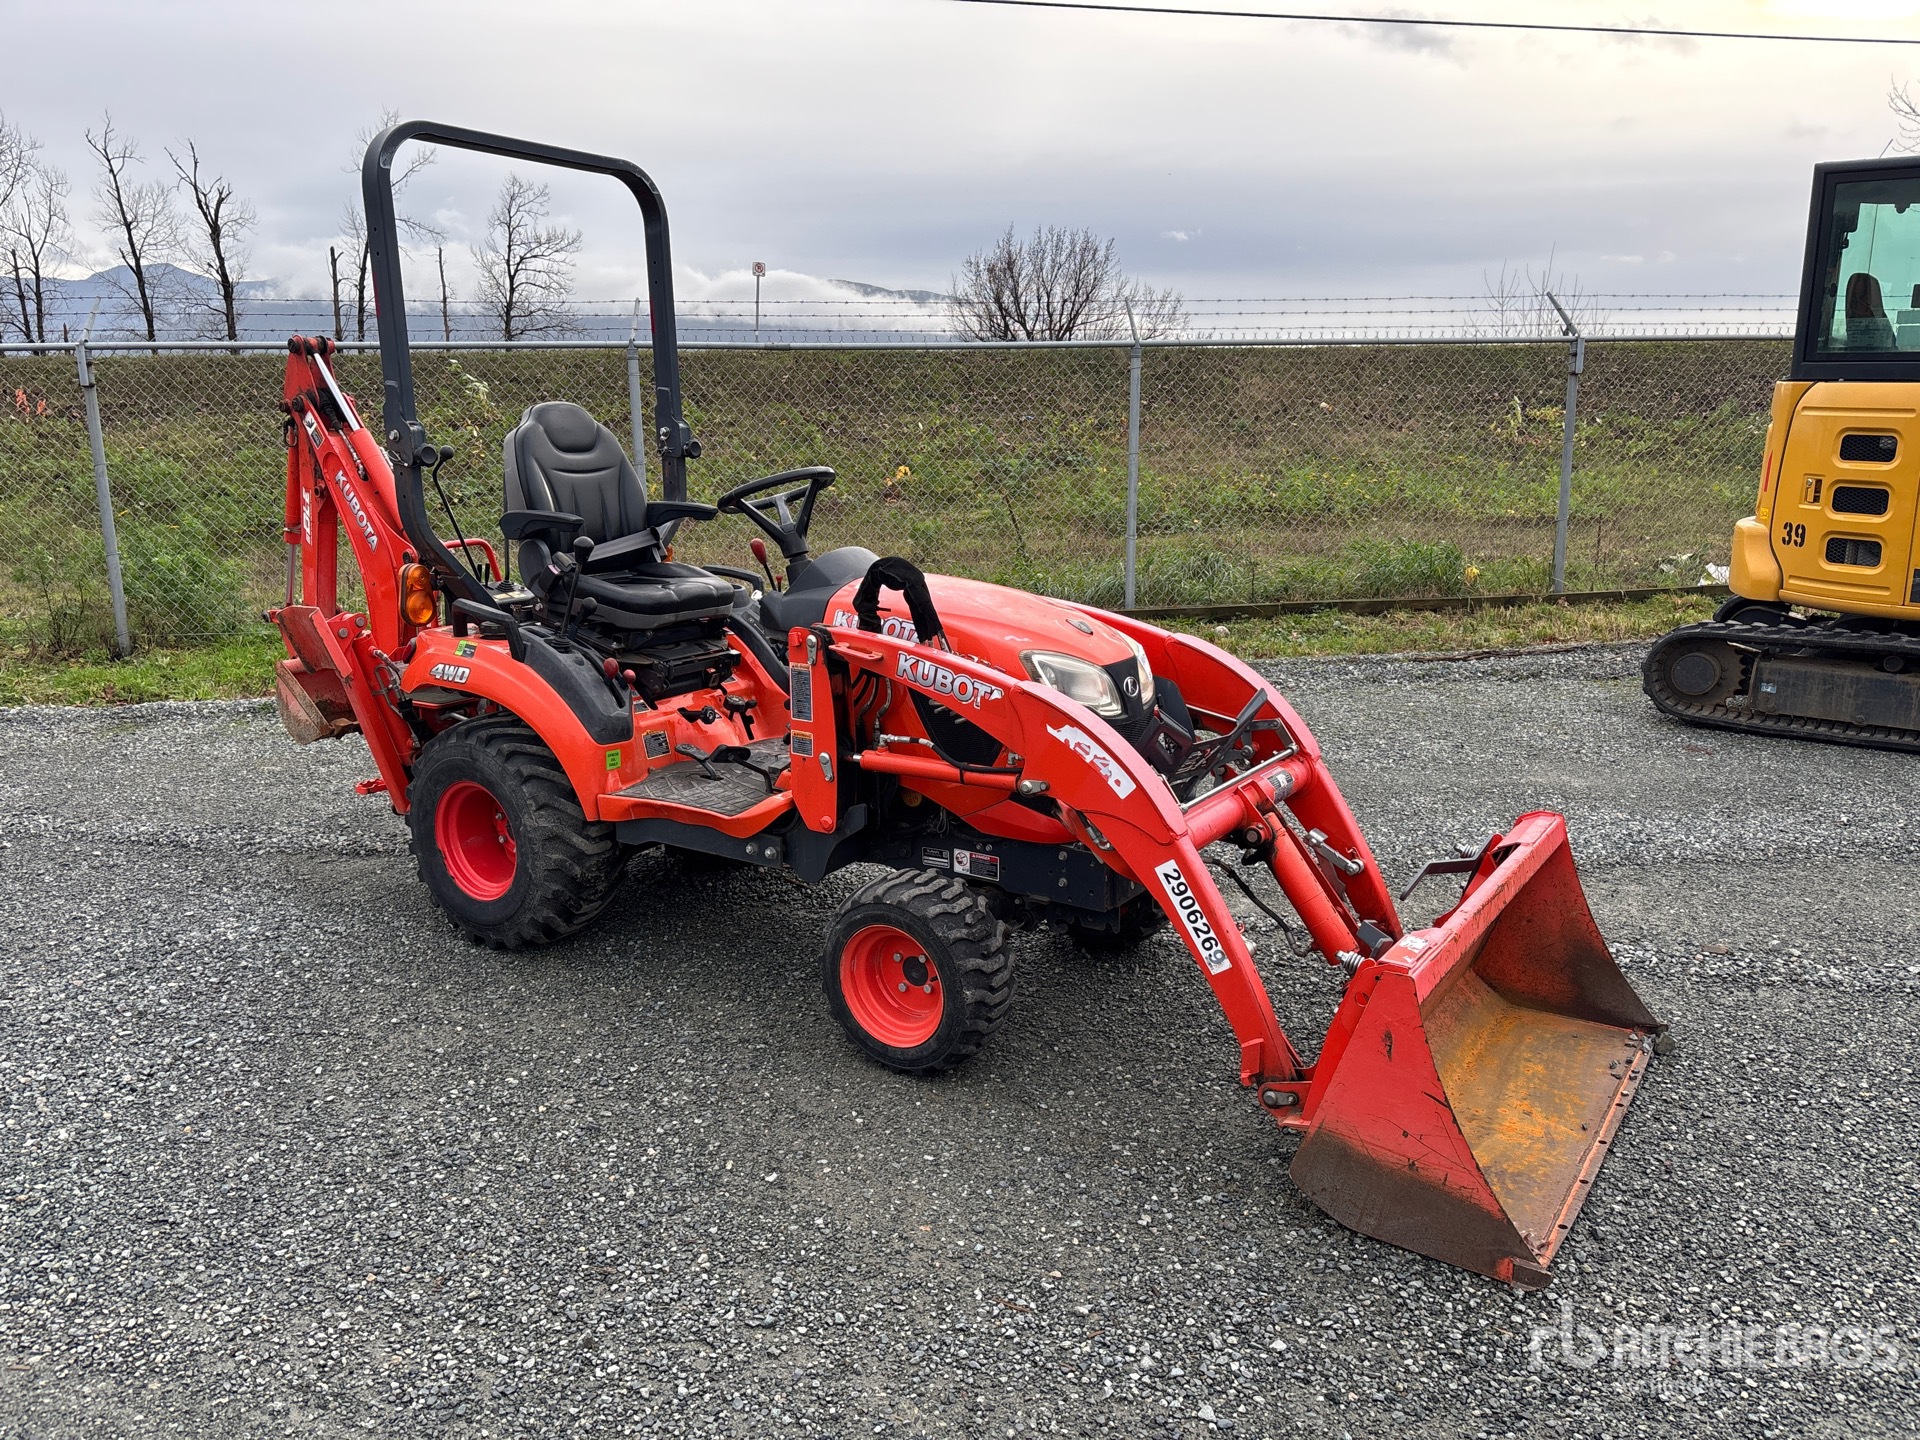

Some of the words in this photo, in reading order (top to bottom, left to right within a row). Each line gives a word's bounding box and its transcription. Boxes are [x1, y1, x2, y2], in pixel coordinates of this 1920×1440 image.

[335, 470, 378, 553] KUBOTA
[1781, 521, 1806, 547] 39
[429, 663, 471, 684] 4WD
[1163, 868, 1226, 965] 2906269
